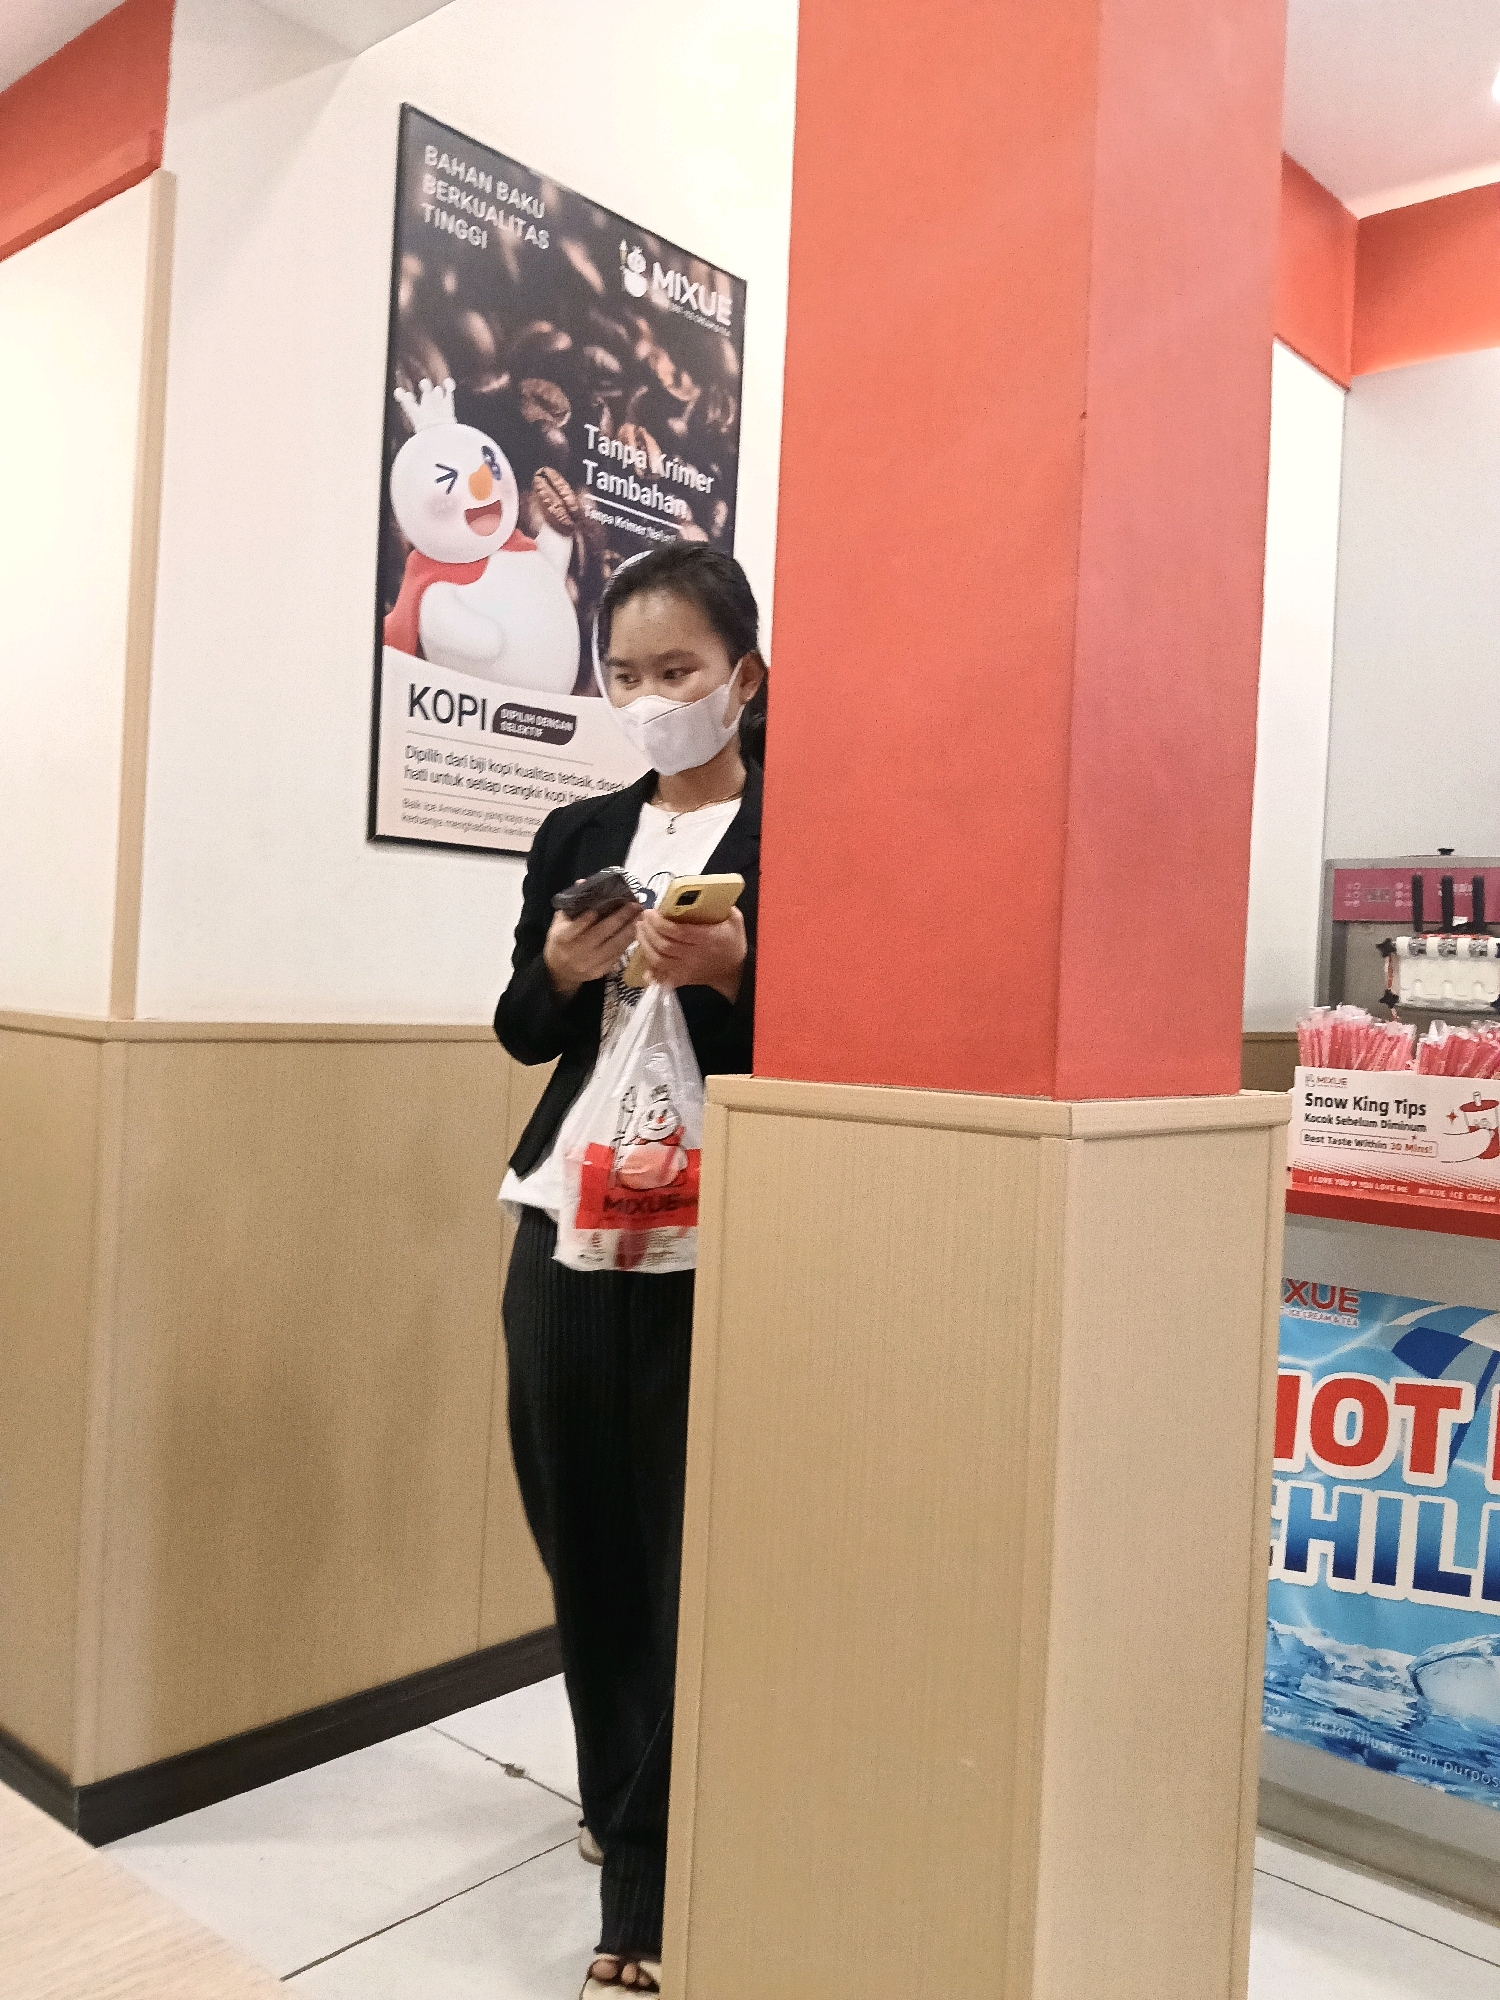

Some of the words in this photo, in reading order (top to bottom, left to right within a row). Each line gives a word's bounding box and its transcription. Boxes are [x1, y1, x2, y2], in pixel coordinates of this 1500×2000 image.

[424, 144, 493, 193] BAHAN
[496, 181, 545, 219] BAKU
[421, 203, 488, 249] TINGGI
[422, 173, 550, 249] BERKUALITAS
[651, 262, 733, 326] MIXUE
[583, 423, 647, 469] Tanpa
[650, 453, 715, 494] Krimer
[582, 459, 688, 519] Tambahan
[408, 683, 487, 731] KOPI
[535, 715, 574, 732] DENGAN
[404, 745, 443, 764] Dipilih
[445, 751, 468, 768] dari
[469, 755, 487, 774] biji
[488, 759, 514, 777] kopi
[514, 762, 557, 783] kualitas
[404, 764, 429, 782] hati
[429, 771, 464, 788] untuk
[465, 777, 501, 795] setiap
[502, 783, 543, 800] cangkir
[544, 787, 568, 804] kopi
[1304, 1092, 1349, 1110] Snow
[1352, 1095, 1390, 1117] King
[1393, 1098, 1427, 1120] Tips
[1304, 1112, 1333, 1125] Kocok
[1335, 1115, 1378, 1129] Sebelum
[1380, 1119, 1428, 1133] Diminum
[1304, 1133, 1325, 1145] Best
[1327, 1135, 1352, 1147] Taste
[1354, 1138, 1388, 1150] Within
